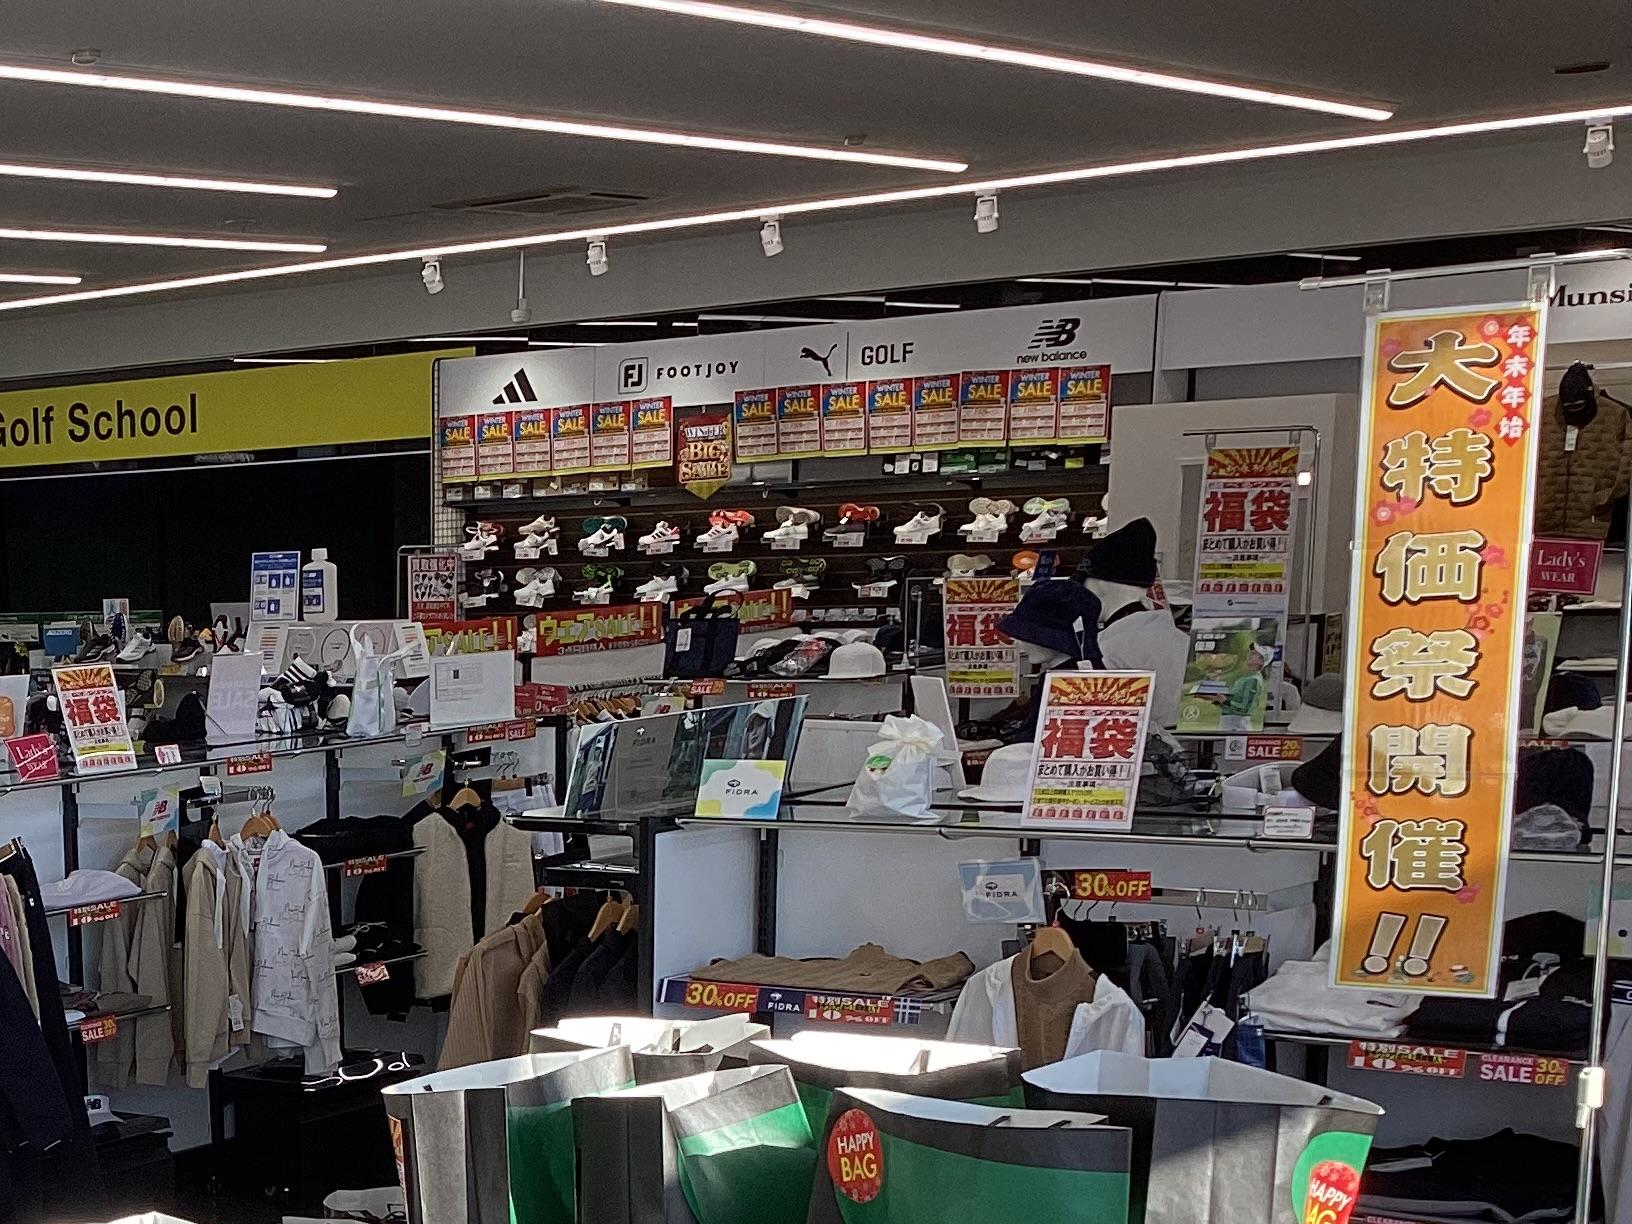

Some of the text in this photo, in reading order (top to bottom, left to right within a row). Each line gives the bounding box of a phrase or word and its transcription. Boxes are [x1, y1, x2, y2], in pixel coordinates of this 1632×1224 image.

[861, 342, 914, 366] GOLF
[1016, 349, 1088, 364] new balance
[656, 360, 739, 380] FOOTJOY
[1018, 381, 1052, 397] SALE
[1067, 378, 1102, 395] SALE
[1498, 325, 1532, 438] 年末年始
[874, 391, 907, 407] SALE
[921, 388, 953, 403] SALE
[968, 384, 1002, 399] SALE
[784, 398, 814, 413] SALE
[828, 394, 860, 410] SALE
[67, 393, 198, 444] School
[558, 416, 584, 432] SALE
[638, 409, 666, 424] SALE
[482, 424, 507, 438] SALE
[520, 421, 546, 435] SALE
[1203, 490, 1291, 532] 福袋
[1537, 550, 1586, 568] Lady's
[1541, 571, 1576, 583] WEAR
[946, 612, 1013, 647] 福袋
[1360, 328, 1500, 977] 大特価祭開催!!
[65, 696, 121, 727] 福袋
[1041, 718, 1138, 760] 福袋
[15, 744, 55, 761] Lady's
[1247, 745, 1280, 759] SALE
[1282, 749, 1300, 759] OFF
[725, 788, 758, 796] FIDRA
[1077, 872, 1150, 898] 30%OFF
[986, 890, 1018, 898] FIDRA
[687, 983, 757, 1008] 30%OFF
[768, 1001, 801, 1012] FIDRA
[81, 1030, 103, 1043] SALE
[1481, 1055, 1534, 1066] CLEARANCE
[1480, 1064, 1532, 1083] SALE
[1534, 1073, 1564, 1086] OFF
[837, 1131, 875, 1155] HAPPY
[840, 1153, 878, 1183] BAG
[1310, 1180, 1353, 1211] HAPPY
